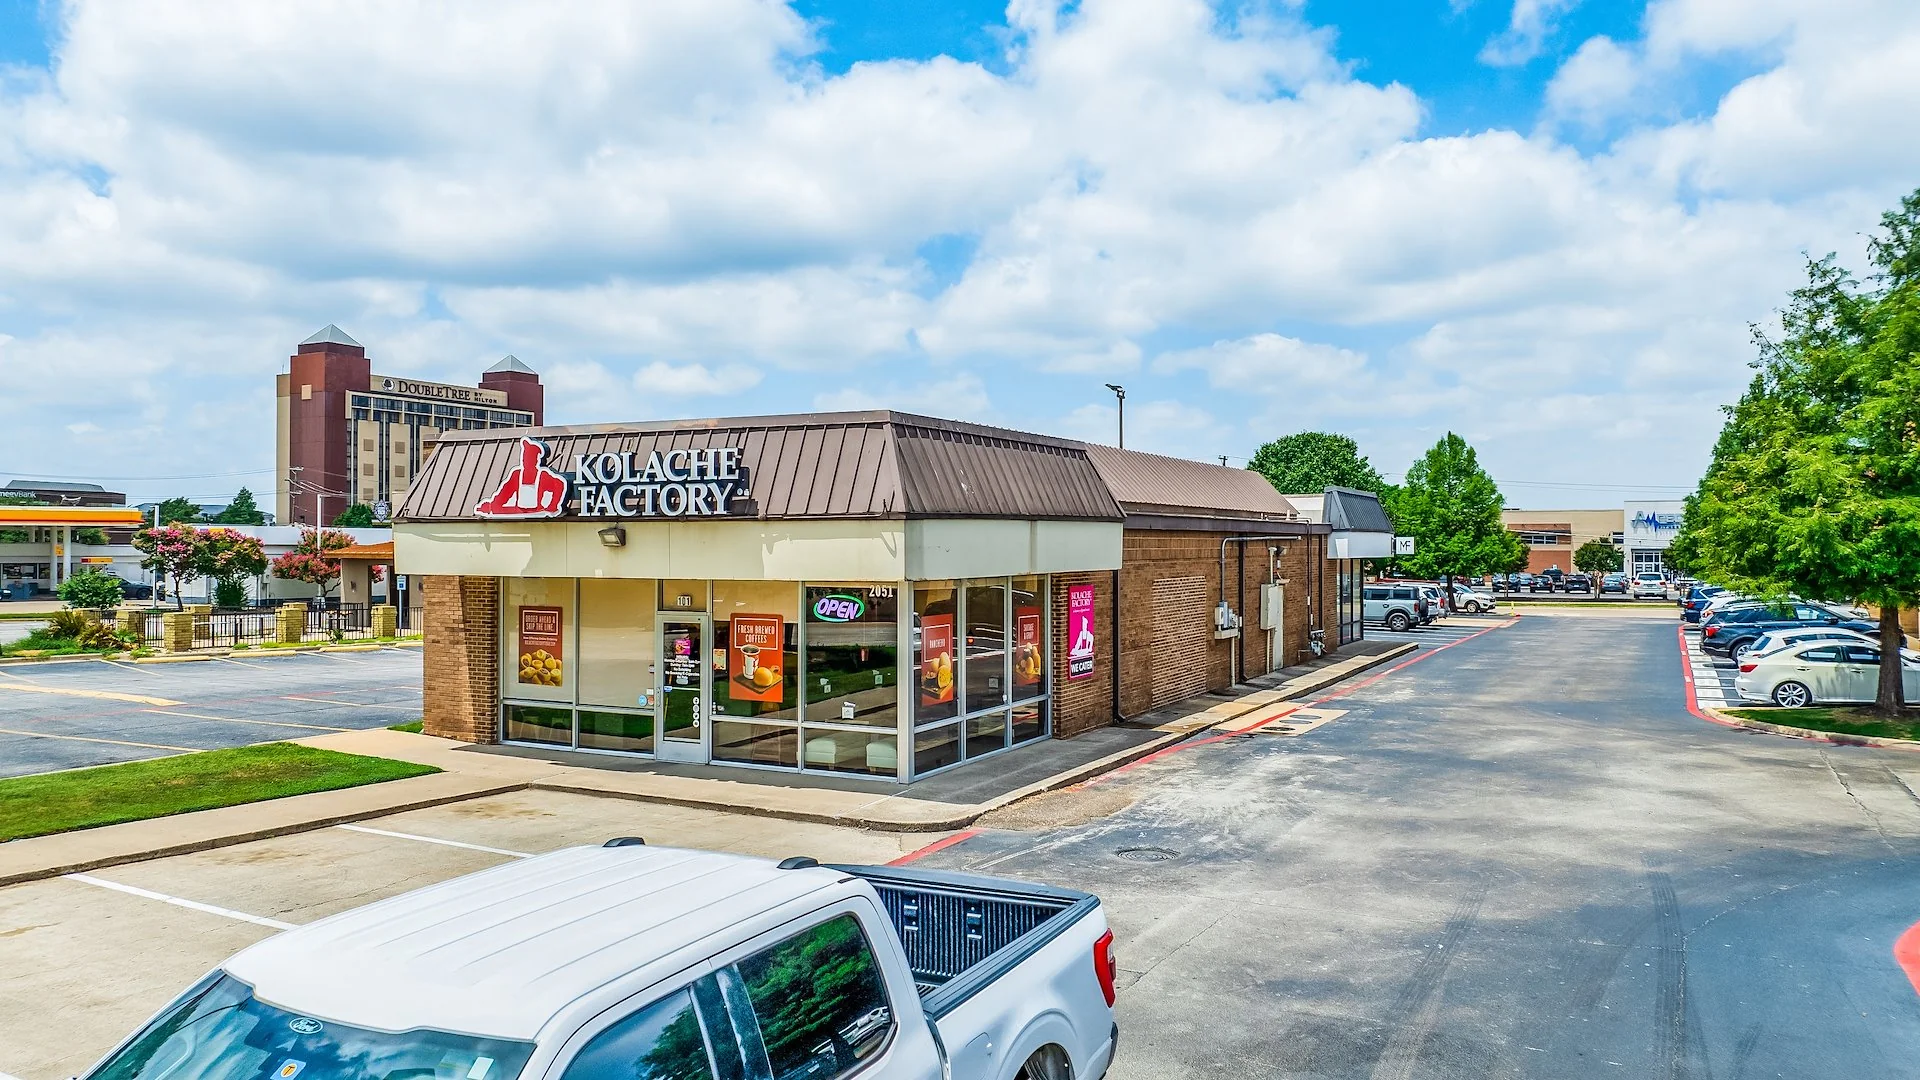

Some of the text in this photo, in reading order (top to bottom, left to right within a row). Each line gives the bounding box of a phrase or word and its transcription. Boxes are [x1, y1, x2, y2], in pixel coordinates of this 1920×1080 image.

[573, 447, 740, 484] KOLACHE
[577, 482, 733, 517] FACTORY
[1399, 540, 1411, 551] MF
[868, 584, 894, 598] 2051
[677, 595, 691, 607] 101
[817, 598, 859, 620] OPEN
[737, 624, 776, 635] FRESH BREWED
[745, 633, 768, 643] COFFEES
[1070, 660, 1093, 673] WE CATER
[293, 1019, 319, 1032] Ford
